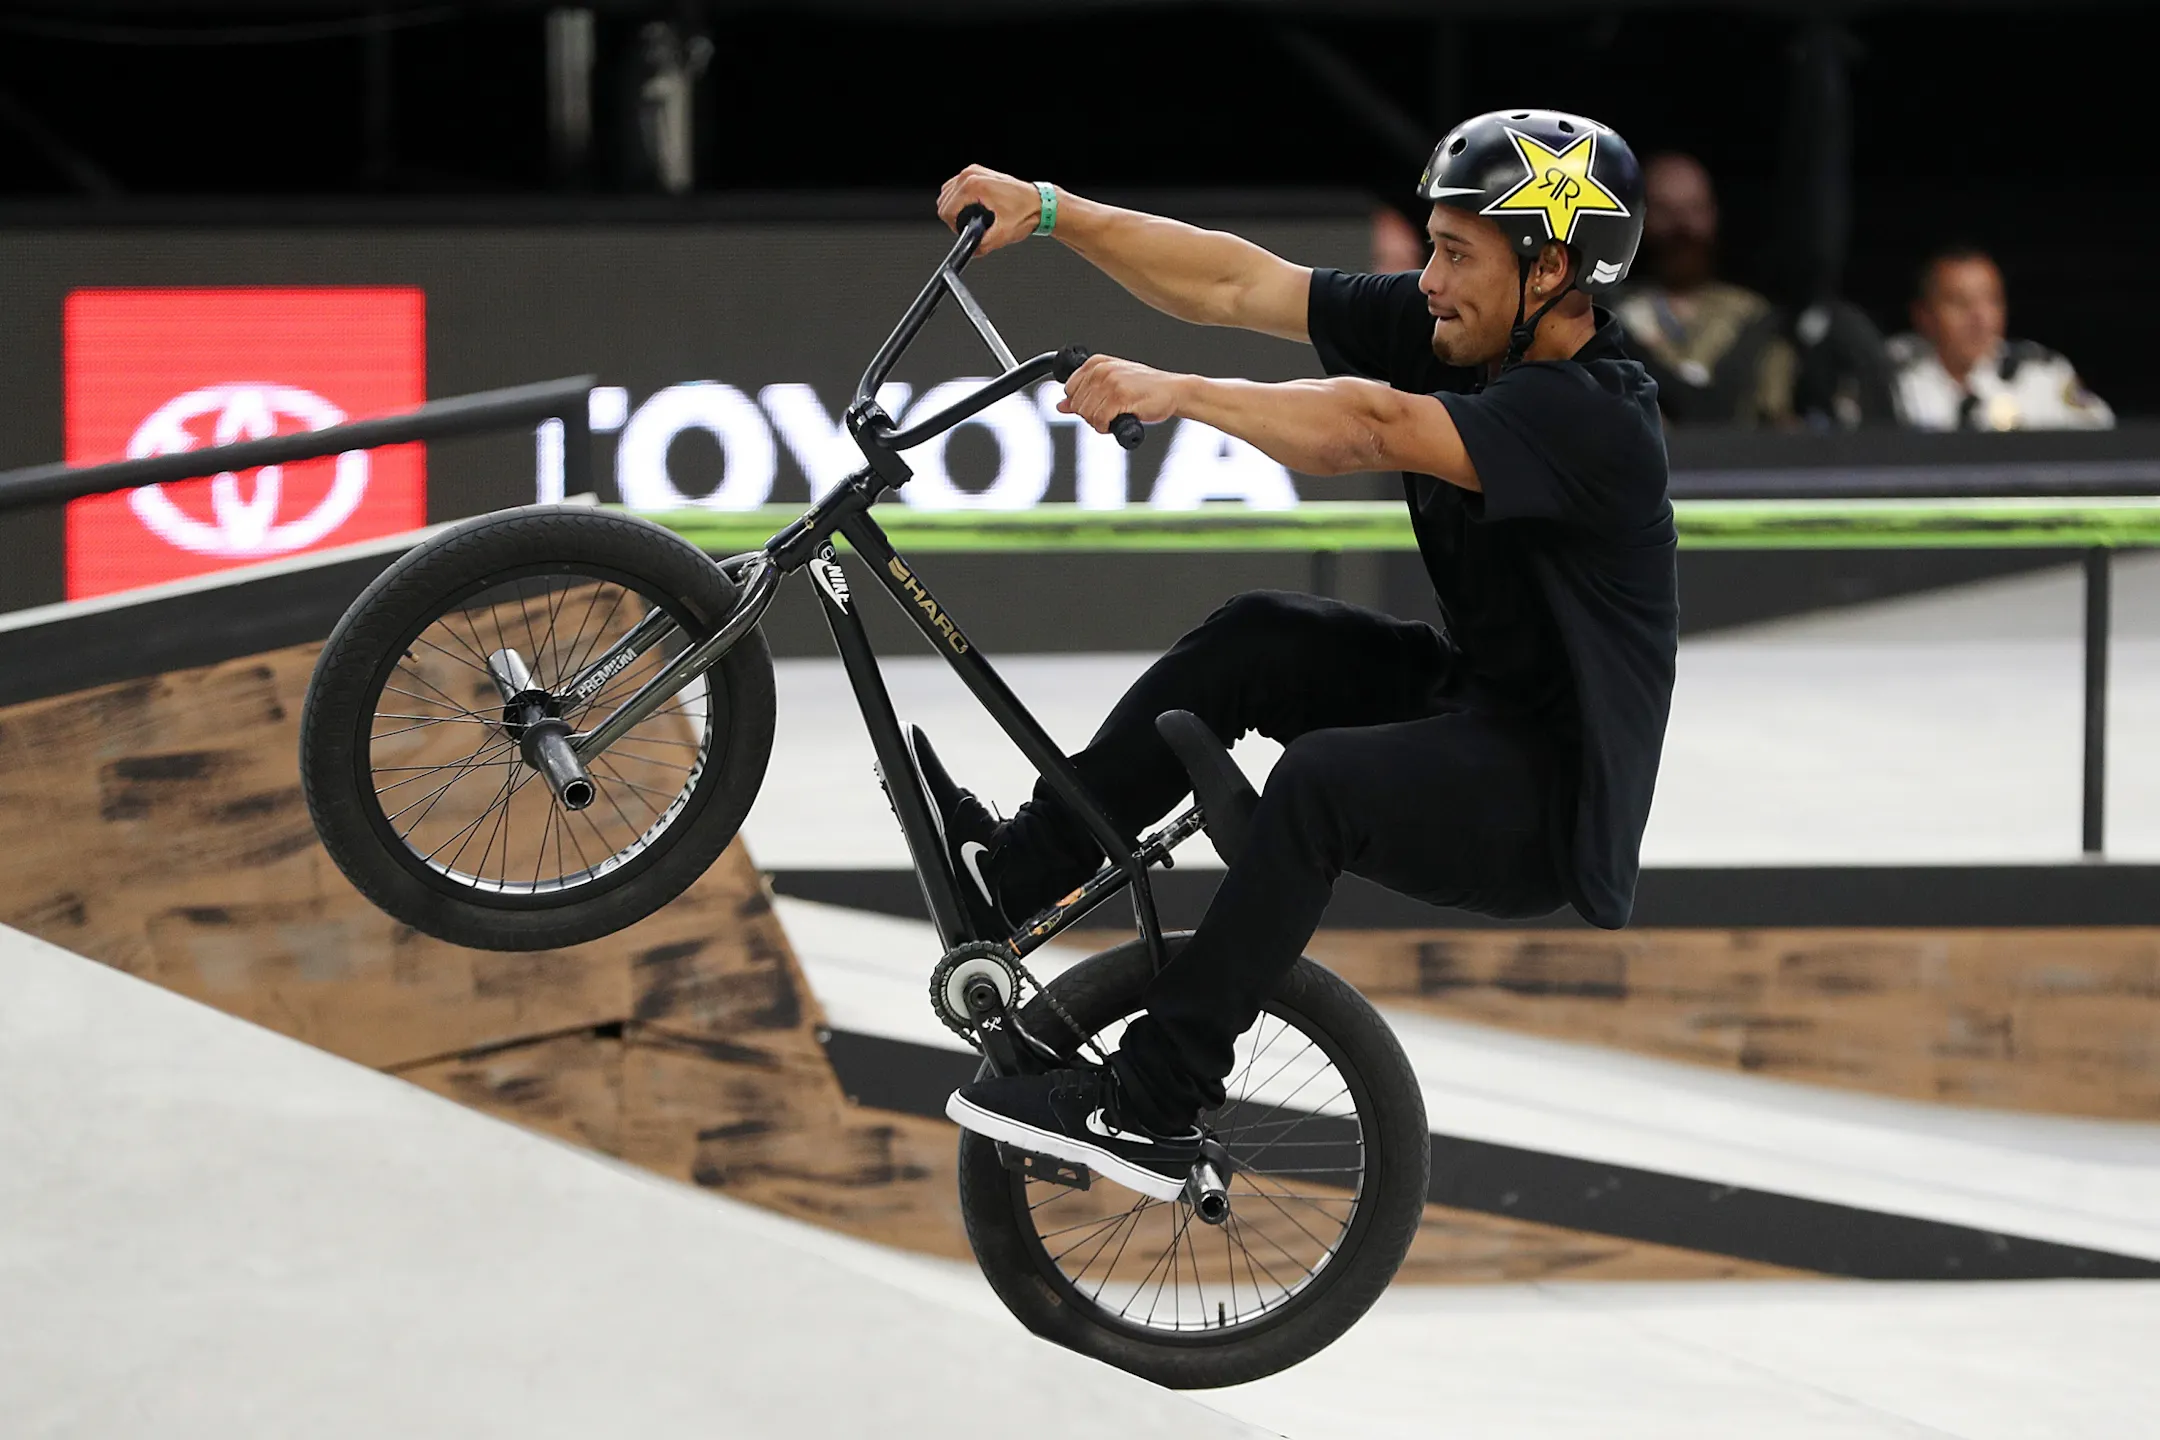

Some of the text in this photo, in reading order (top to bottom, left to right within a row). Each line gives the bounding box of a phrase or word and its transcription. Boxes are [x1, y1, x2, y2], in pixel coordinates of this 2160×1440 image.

[827, 565, 850, 603] NIKE
[904, 577, 969, 654] HARO
[576, 647, 638, 698] PREMIUM
